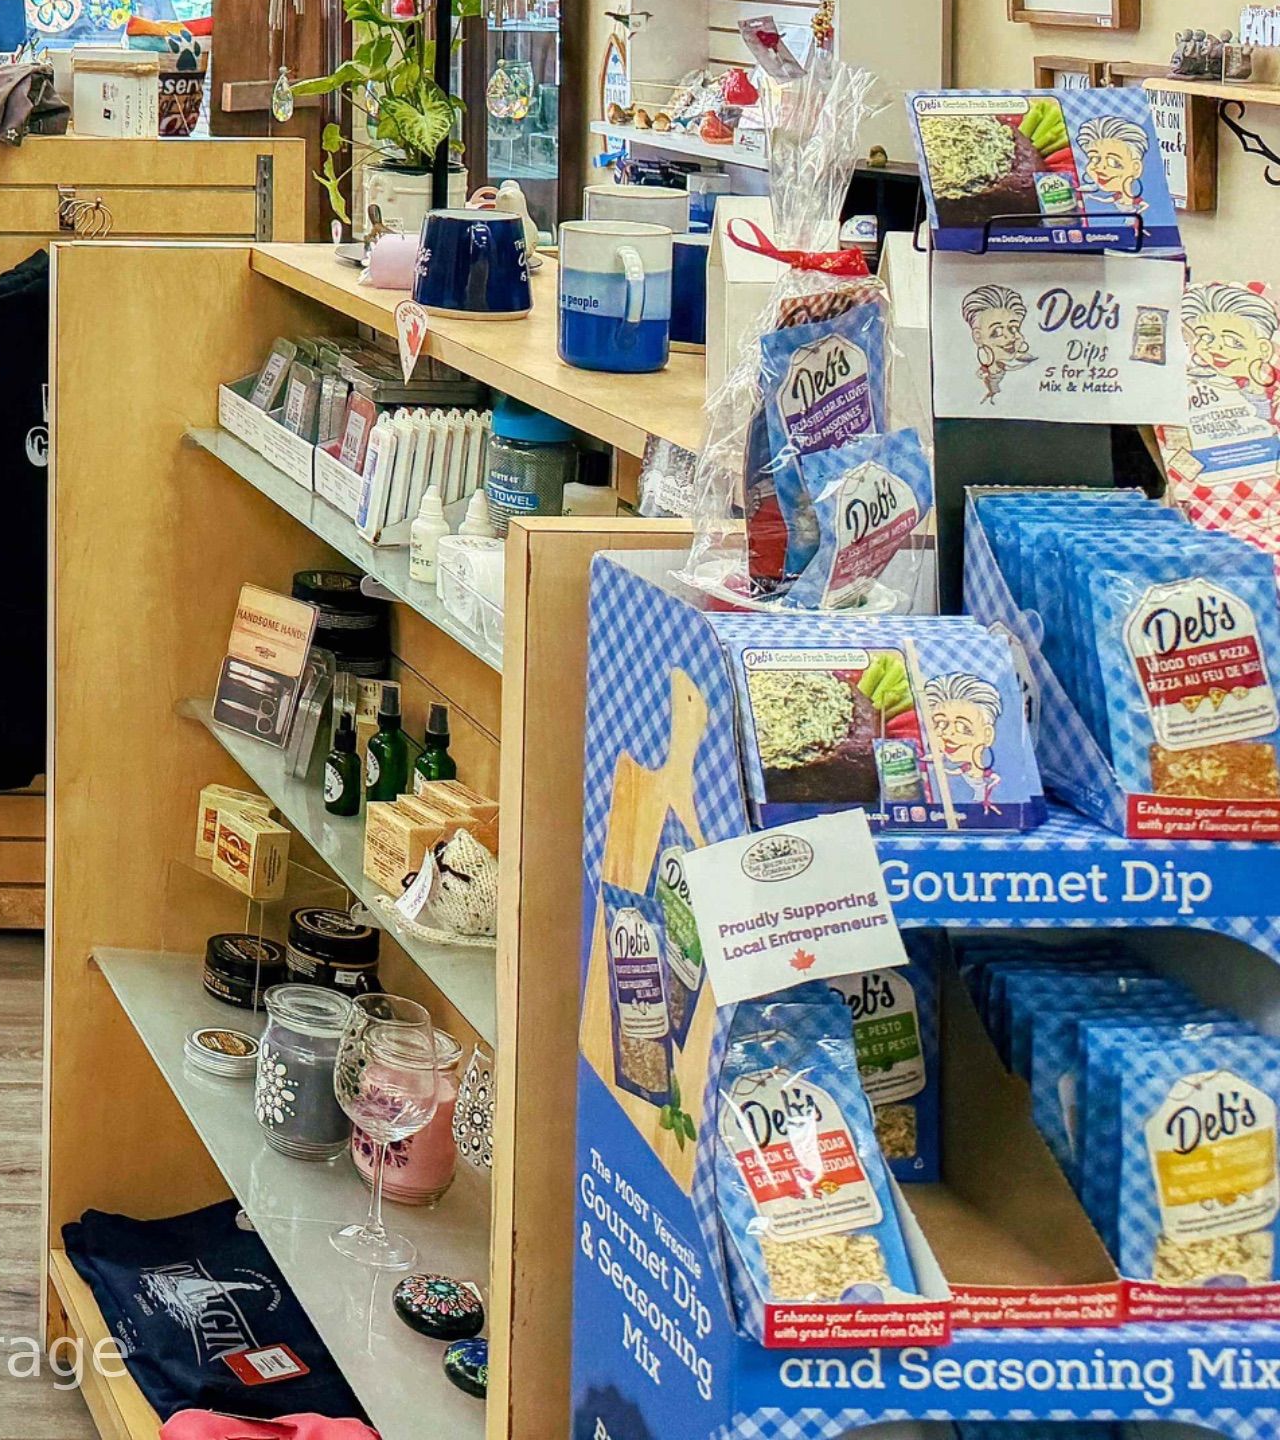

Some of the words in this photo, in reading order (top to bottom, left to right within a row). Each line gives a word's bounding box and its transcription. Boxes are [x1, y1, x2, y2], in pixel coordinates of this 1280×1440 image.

[917, 99, 942, 112] Deb's
[943, 100, 966, 108] Garden
[968, 100, 987, 108] Fresh
[1168, 114, 1180, 130] ON
[567, 295, 599, 310] people
[1037, 287, 1121, 332] Deb's
[1067, 339, 1109, 367] Dips
[792, 346, 851, 414] Deb's
[1045, 366, 1056, 377] 5
[1062, 364, 1084, 378] for
[1089, 366, 1118, 379] $20
[1039, 380, 1061, 392] Mix
[1066, 382, 1077, 392] &
[1082, 381, 1123, 392] Match
[1188, 385, 1219, 410] eb's
[790, 411, 824, 434] ROASTED
[824, 394, 846, 416] GARLIC
[494, 491, 534, 507] TOWEL
[846, 477, 897, 545] Deb's
[236, 608, 279, 631] HANDSOME
[281, 624, 306, 640] HANDS
[1143, 595, 1236, 657] Deb's
[746, 651, 774, 665] Deb's
[775, 652, 801, 663] Garden
[1147, 656, 1184, 674] WOOD
[1187, 650, 1218, 667] OVEN
[1220, 644, 1251, 661] PIZZA
[1184, 671, 1200, 686] AU
[1202, 667, 1224, 683] FEU
[1225, 663, 1241, 679] DE
[1136, 801, 1193, 816] Enhance
[1195, 805, 1223, 818] your
[1136, 818, 1163, 830] with
[1164, 820, 1196, 834] great
[1198, 820, 1249, 832] flavours
[1250, 820, 1280, 832] from
[882, 863, 1110, 904] Gourmet
[1120, 863, 1213, 914] Dip
[718, 910, 781, 939] Proudly
[782, 891, 879, 921] Supporting
[615, 919, 650, 960] Deb's
[722, 937, 767, 961] Local
[769, 913, 888, 949] Entrepreneurs
[868, 1021, 903, 1037] PESTO
[872, 1042, 885, 1056] ET
[887, 1036, 918, 1054] PESTO
[1166, 1091, 1256, 1156] Deb's
[745, 1150, 782, 1169] BACON
[753, 1171, 792, 1189] BACON
[590, 1147, 612, 1184] The
[615, 1172, 650, 1223] MOST
[652, 1211, 702, 1280] Versatile
[580, 1173, 670, 1290] Gourmet
[673, 1266, 712, 1339] Dip
[580, 1220, 594, 1260] &
[598, 1237, 713, 1401] Seasoning
[774, 1310, 824, 1324] Enhance
[825, 1312, 852, 1326] your
[854, 1309, 904, 1322] favourite
[774, 1327, 798, 1338] with
[799, 1327, 829, 1341] great
[831, 1325, 879, 1339] flavours
[880, 1323, 907, 1338] from
[622, 1312, 661, 1386] Mix
[779, 1349, 884, 1390] and
[898, 1346, 1175, 1407] Seasoning
[1187, 1347, 1280, 1390] Mix
